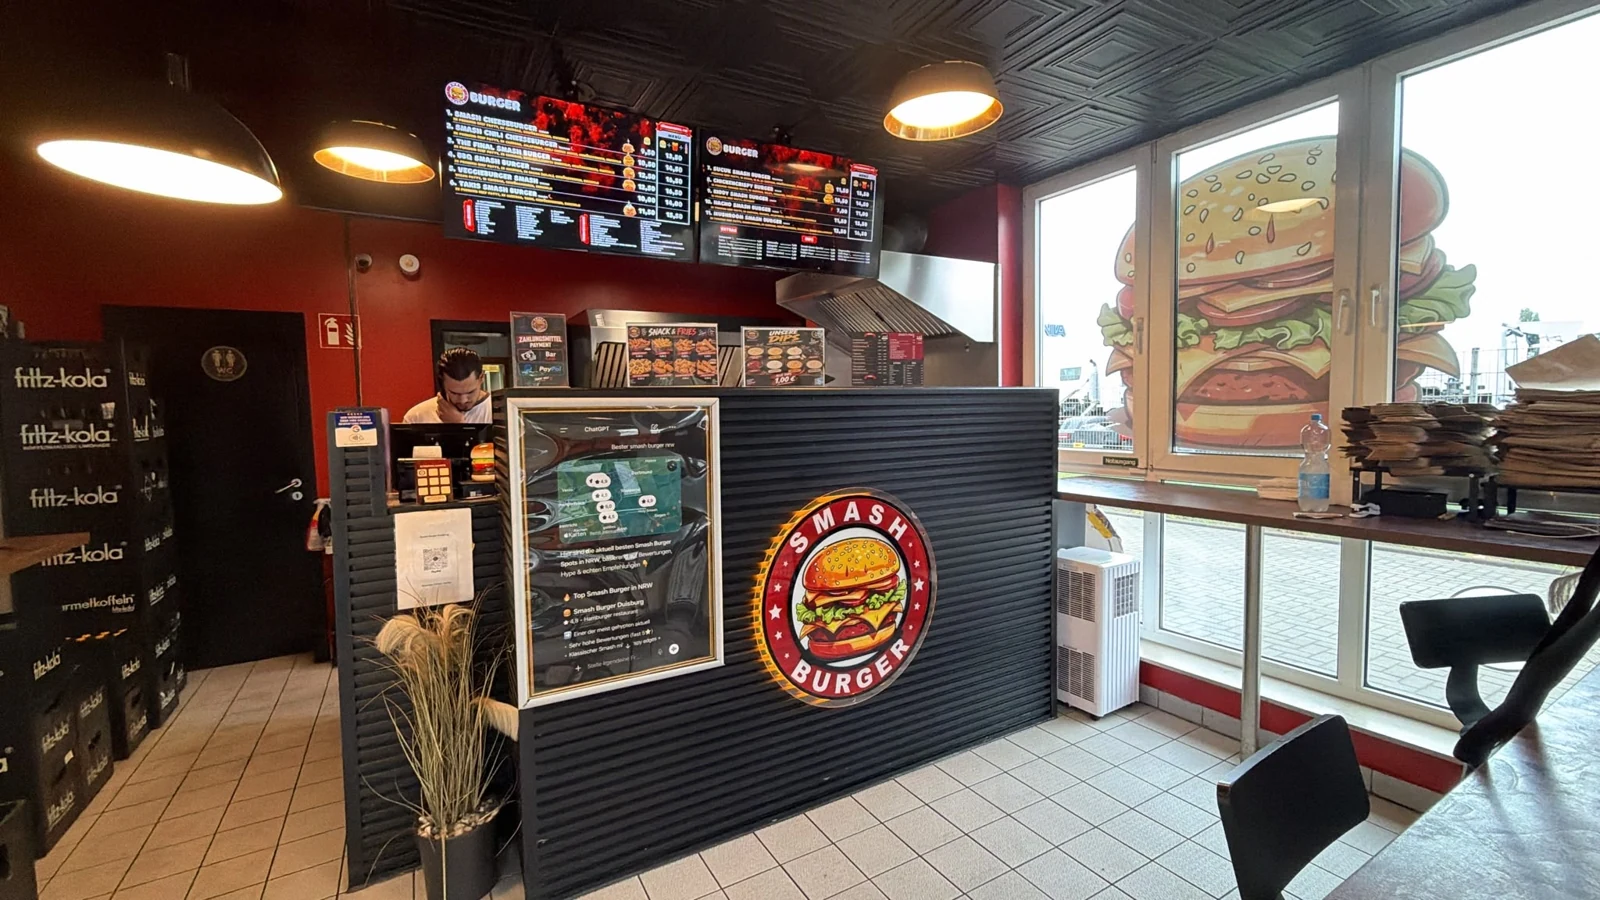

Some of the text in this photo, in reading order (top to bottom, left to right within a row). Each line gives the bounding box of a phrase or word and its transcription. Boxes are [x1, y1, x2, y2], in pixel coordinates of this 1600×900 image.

[470, 92, 520, 111] BURGER
[454, 111, 482, 121] SMASH
[483, 116, 537, 131] CHEESEBURGER
[455, 124, 482, 134] SMASH
[505, 133, 557, 146] CHEESEBURGER
[456, 138, 471, 147] THE
[497, 145, 522, 155] SMASH
[523, 150, 550, 160] BURGER
[723, 144, 758, 158] BURGER
[474, 155, 500, 164] SMASH
[501, 159, 530, 170] BURGER
[458, 166, 512, 181] VEGGIEBURGER
[514, 175, 539, 184] SMASH
[751, 172, 771, 180] BURGER
[482, 184, 508, 193] SMASH
[509, 188, 537, 198] BURGER
[648, 328, 671, 336] SNACK
[768, 334, 800, 343] DIPS
[14, 367, 108, 388] fritz-kola
[20, 423, 110, 444] fritz-kola
[1105, 458, 1136, 466] Notausgang
[30, 485, 118, 508] fritz-kola
[789, 501, 908, 554] SMASH
[654, 540, 671, 548] Burger
[639, 549, 672, 558] Bewertungen,
[602, 562, 640, 572] Empfehlungen
[609, 586, 630, 594] Burger
[573, 599, 644, 615] Smash Burger Duisburg
[596, 634, 629, 643] Bewertungen
[568, 649, 597, 657] Klassischer
[790, 638, 910, 695] BURGER
